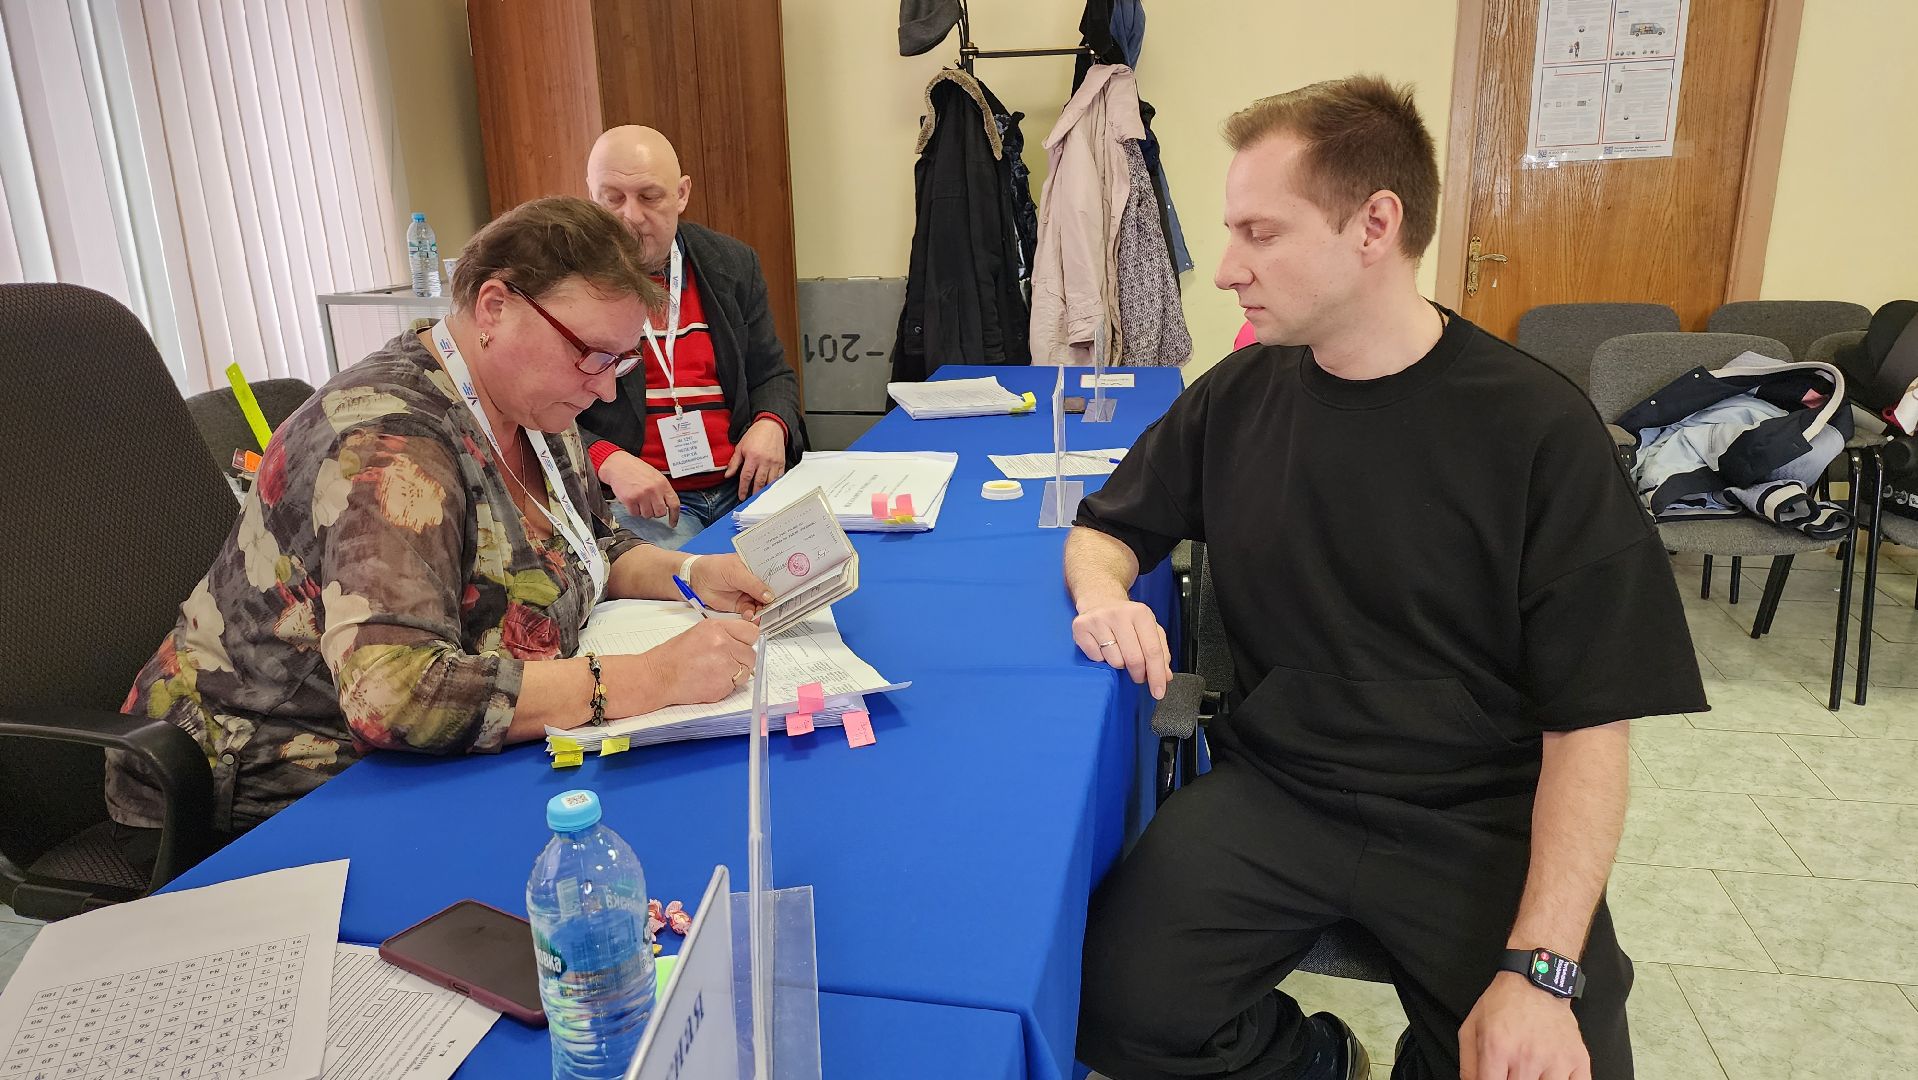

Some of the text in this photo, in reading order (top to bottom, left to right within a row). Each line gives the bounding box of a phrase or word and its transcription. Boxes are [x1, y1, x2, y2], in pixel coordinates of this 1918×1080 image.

[284, 974, 294, 982] 61
[72, 985, 84, 993] 99
[172, 1001, 184, 1009] 65
[226, 1001, 238, 1009] 53
[197, 1008, 209, 1016] 54
[168, 1015, 180, 1023] 55
[108, 1028, 122, 1036] 57
[78, 1035, 91, 1043] 58
